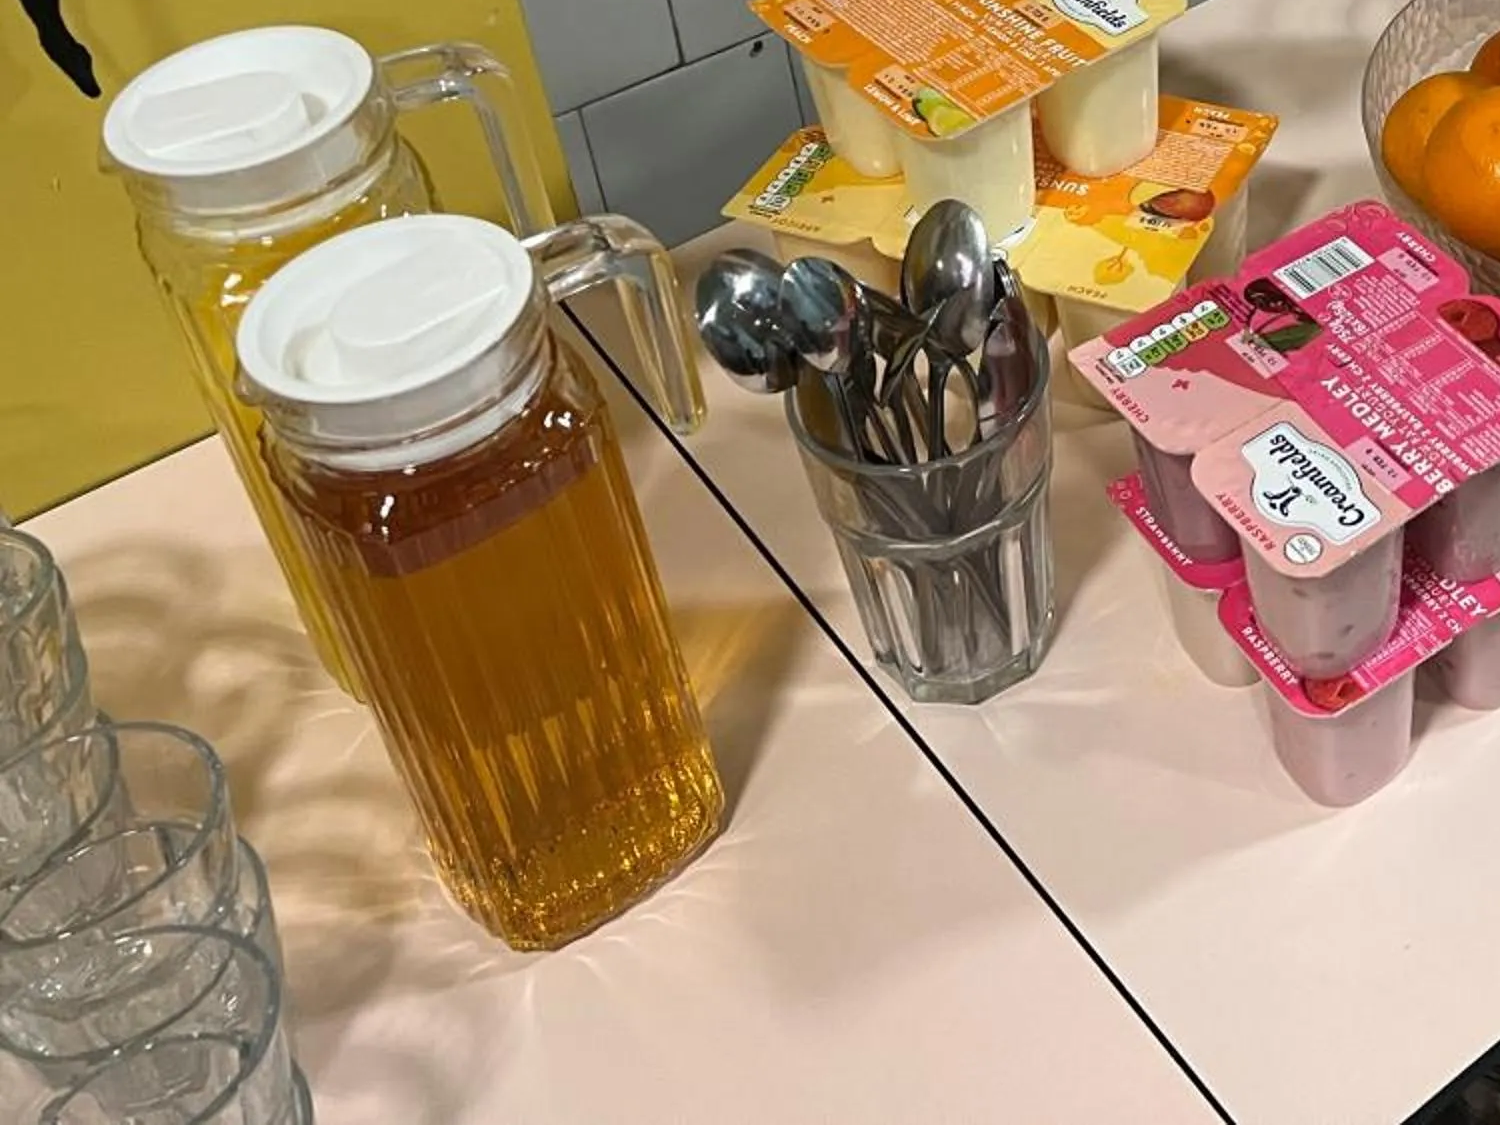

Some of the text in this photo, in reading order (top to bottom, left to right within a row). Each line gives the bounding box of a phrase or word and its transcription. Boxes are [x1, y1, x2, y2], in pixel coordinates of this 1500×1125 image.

[1043, 36, 1087, 68] FRUIT
[1036, 176, 1089, 196] SUNS
[1396, 232, 1436, 262] CHERRY
[1327, 343, 1364, 375] CHERRY
[1111, 387, 1149, 423] CHERRY
[1369, 382, 1425, 432] RASPBERRY
[1320, 376, 1456, 494] BERRY MEDLEY
[1270, 434, 1365, 526] Creamfields
[1135, 506, 1193, 567] STRAWBERRY
[1215, 492, 1277, 551] RASPBERRY
[1431, 572, 1488, 617] DLEY
[1241, 625, 1299, 685] RASPBERRY
